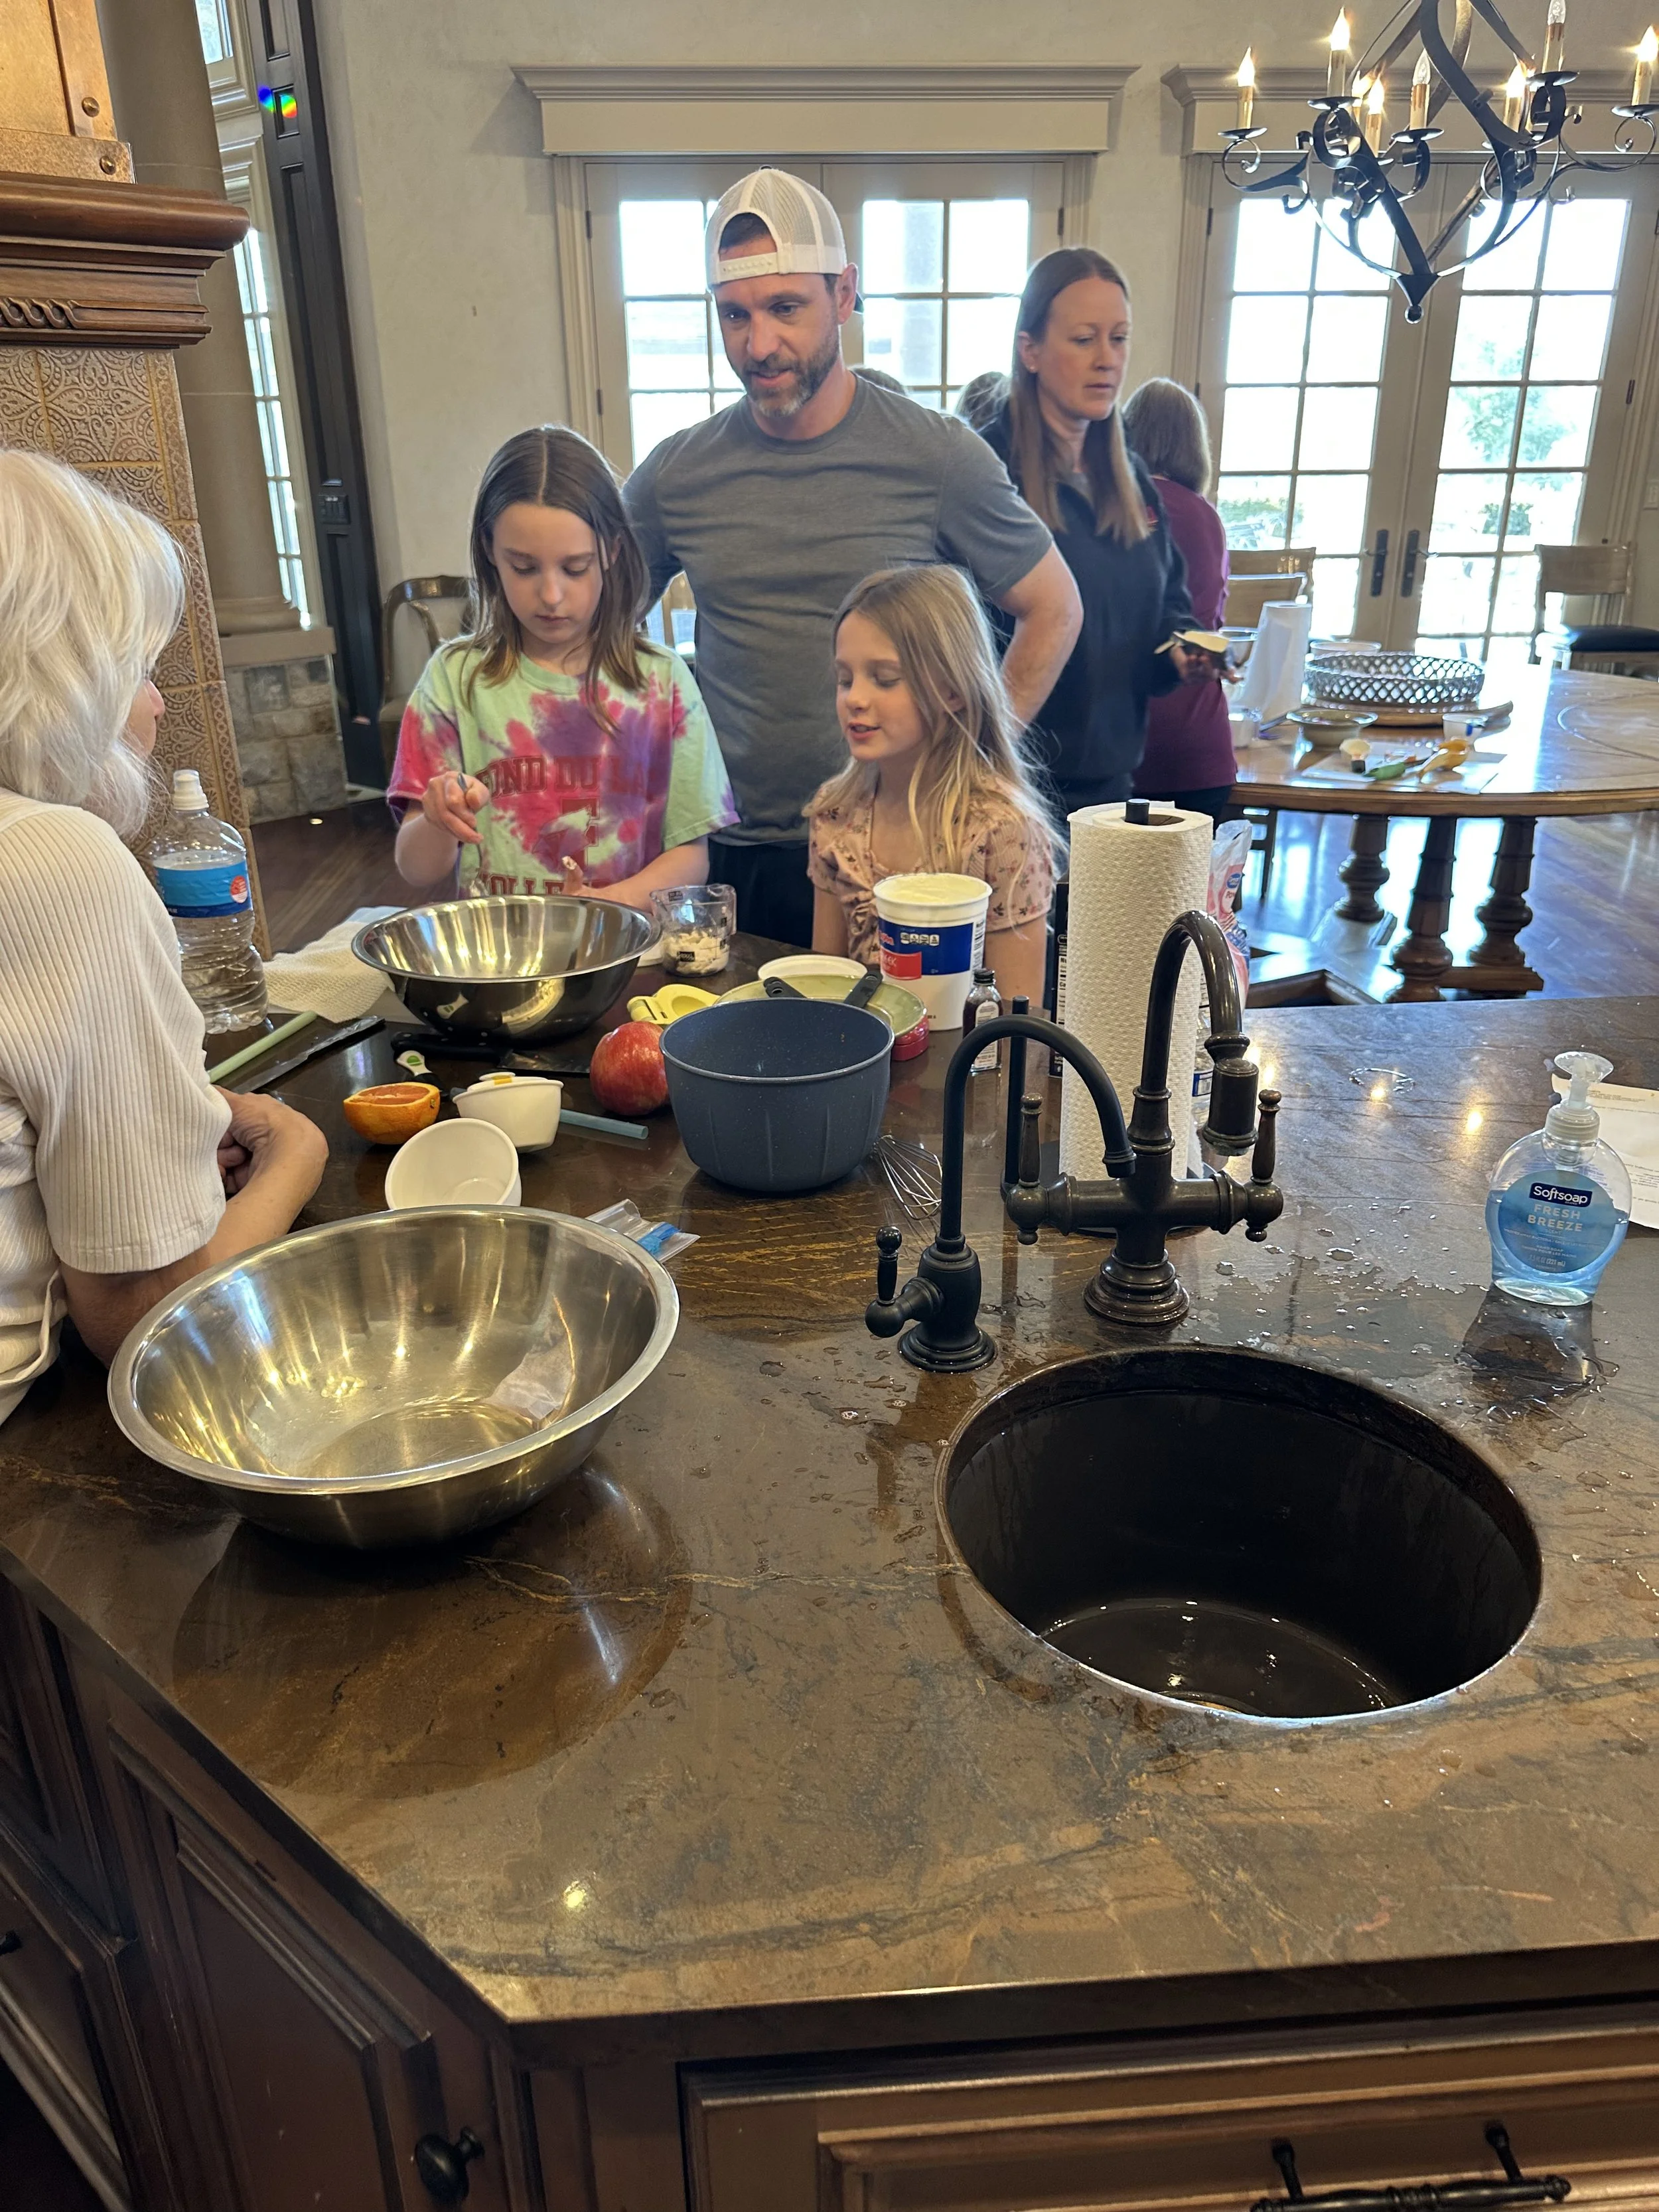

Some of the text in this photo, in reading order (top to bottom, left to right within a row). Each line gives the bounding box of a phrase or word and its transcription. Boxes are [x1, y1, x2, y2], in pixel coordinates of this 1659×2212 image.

[474, 755, 547, 801] OND
[553, 754, 600, 792] DU
[1533, 1185, 1588, 1205] Softsoap
[1534, 1204, 1581, 1219] FRESH
[1528, 1215, 1583, 1232] BREEZE
